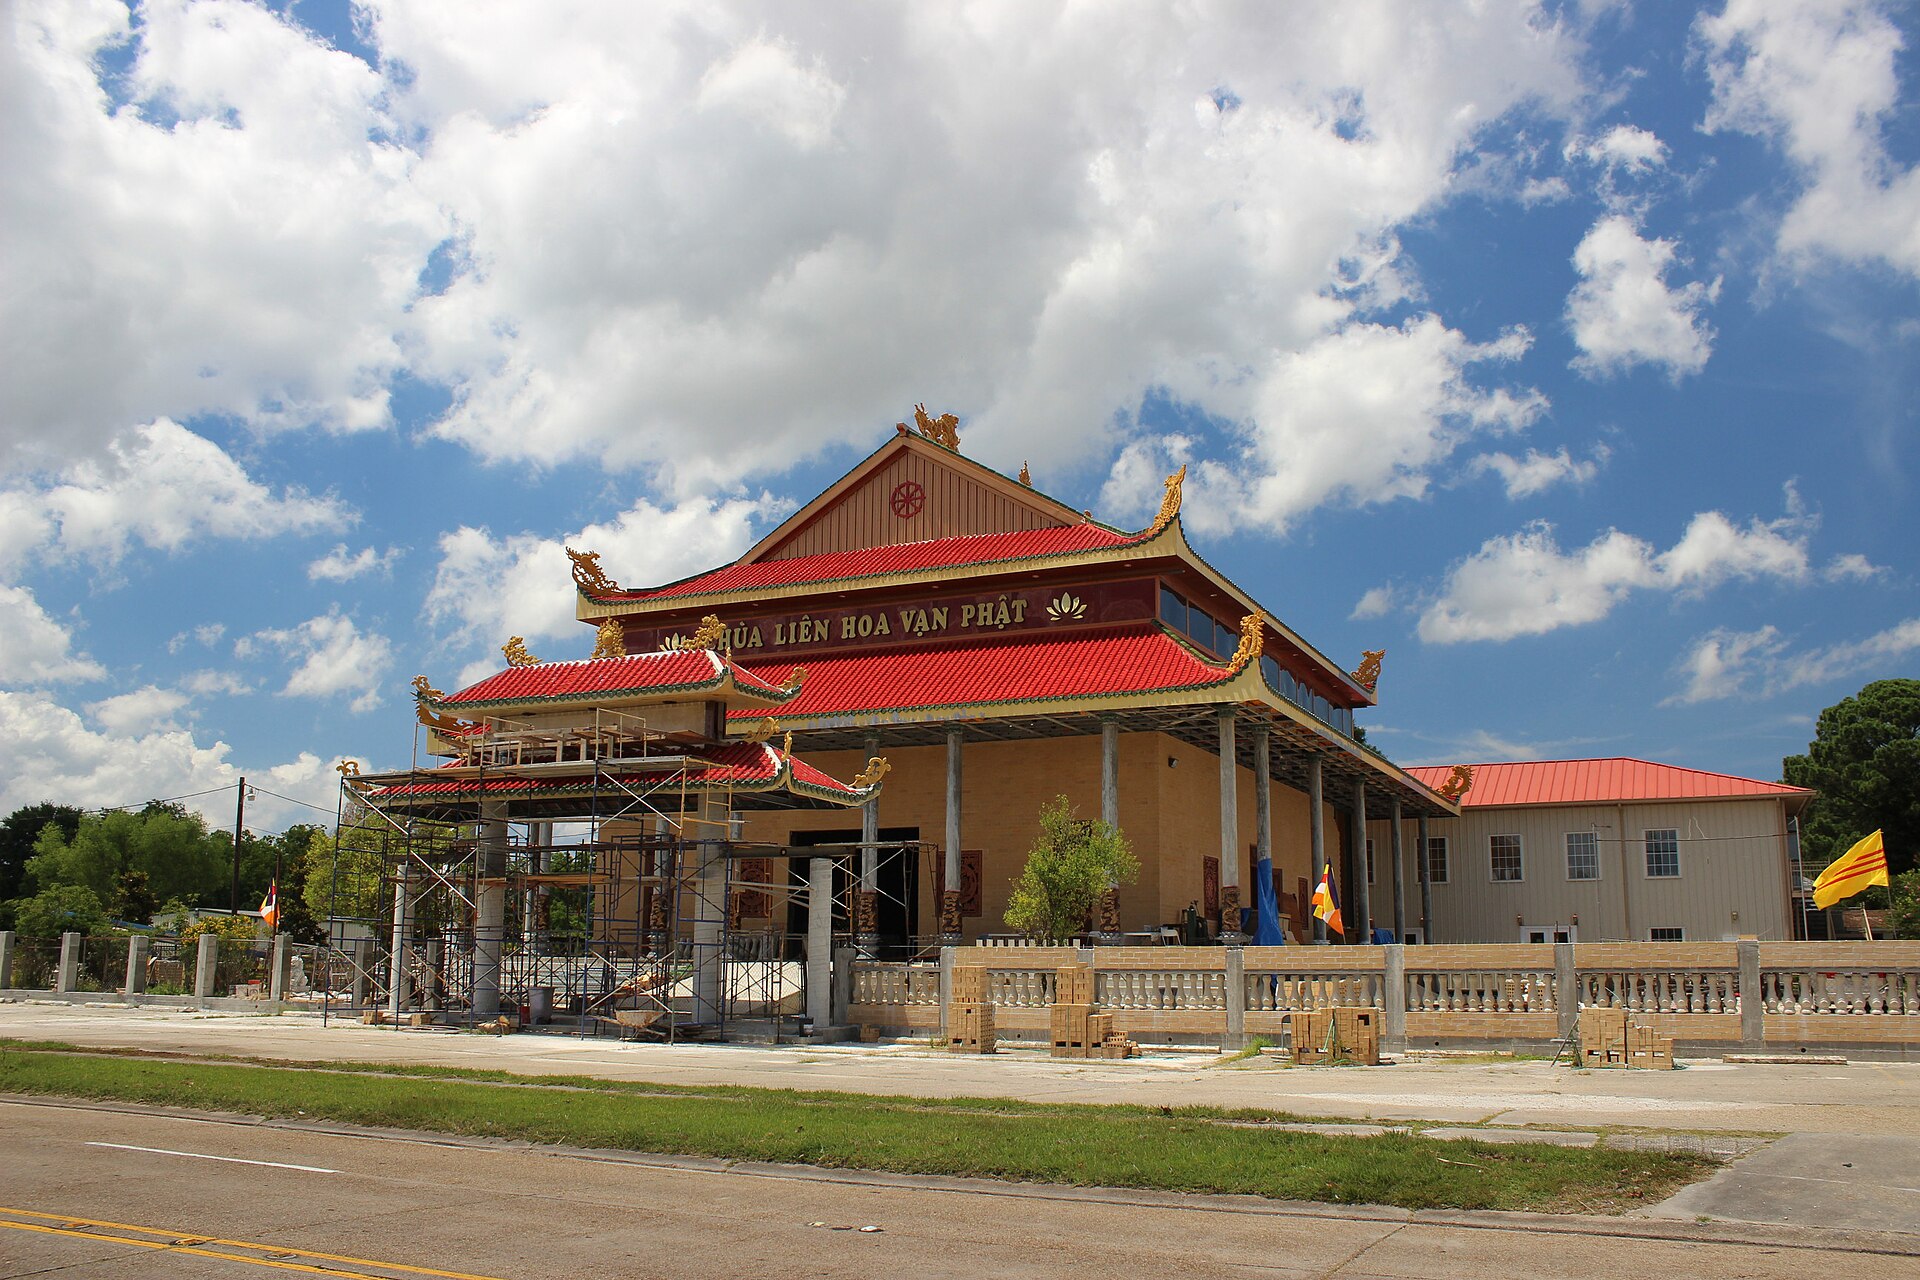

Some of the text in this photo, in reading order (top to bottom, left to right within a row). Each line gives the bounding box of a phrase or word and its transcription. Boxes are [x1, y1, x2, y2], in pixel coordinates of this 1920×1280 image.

[707, 594, 1028, 650] HÙA LIÊN HOA VẠN PHẬT
